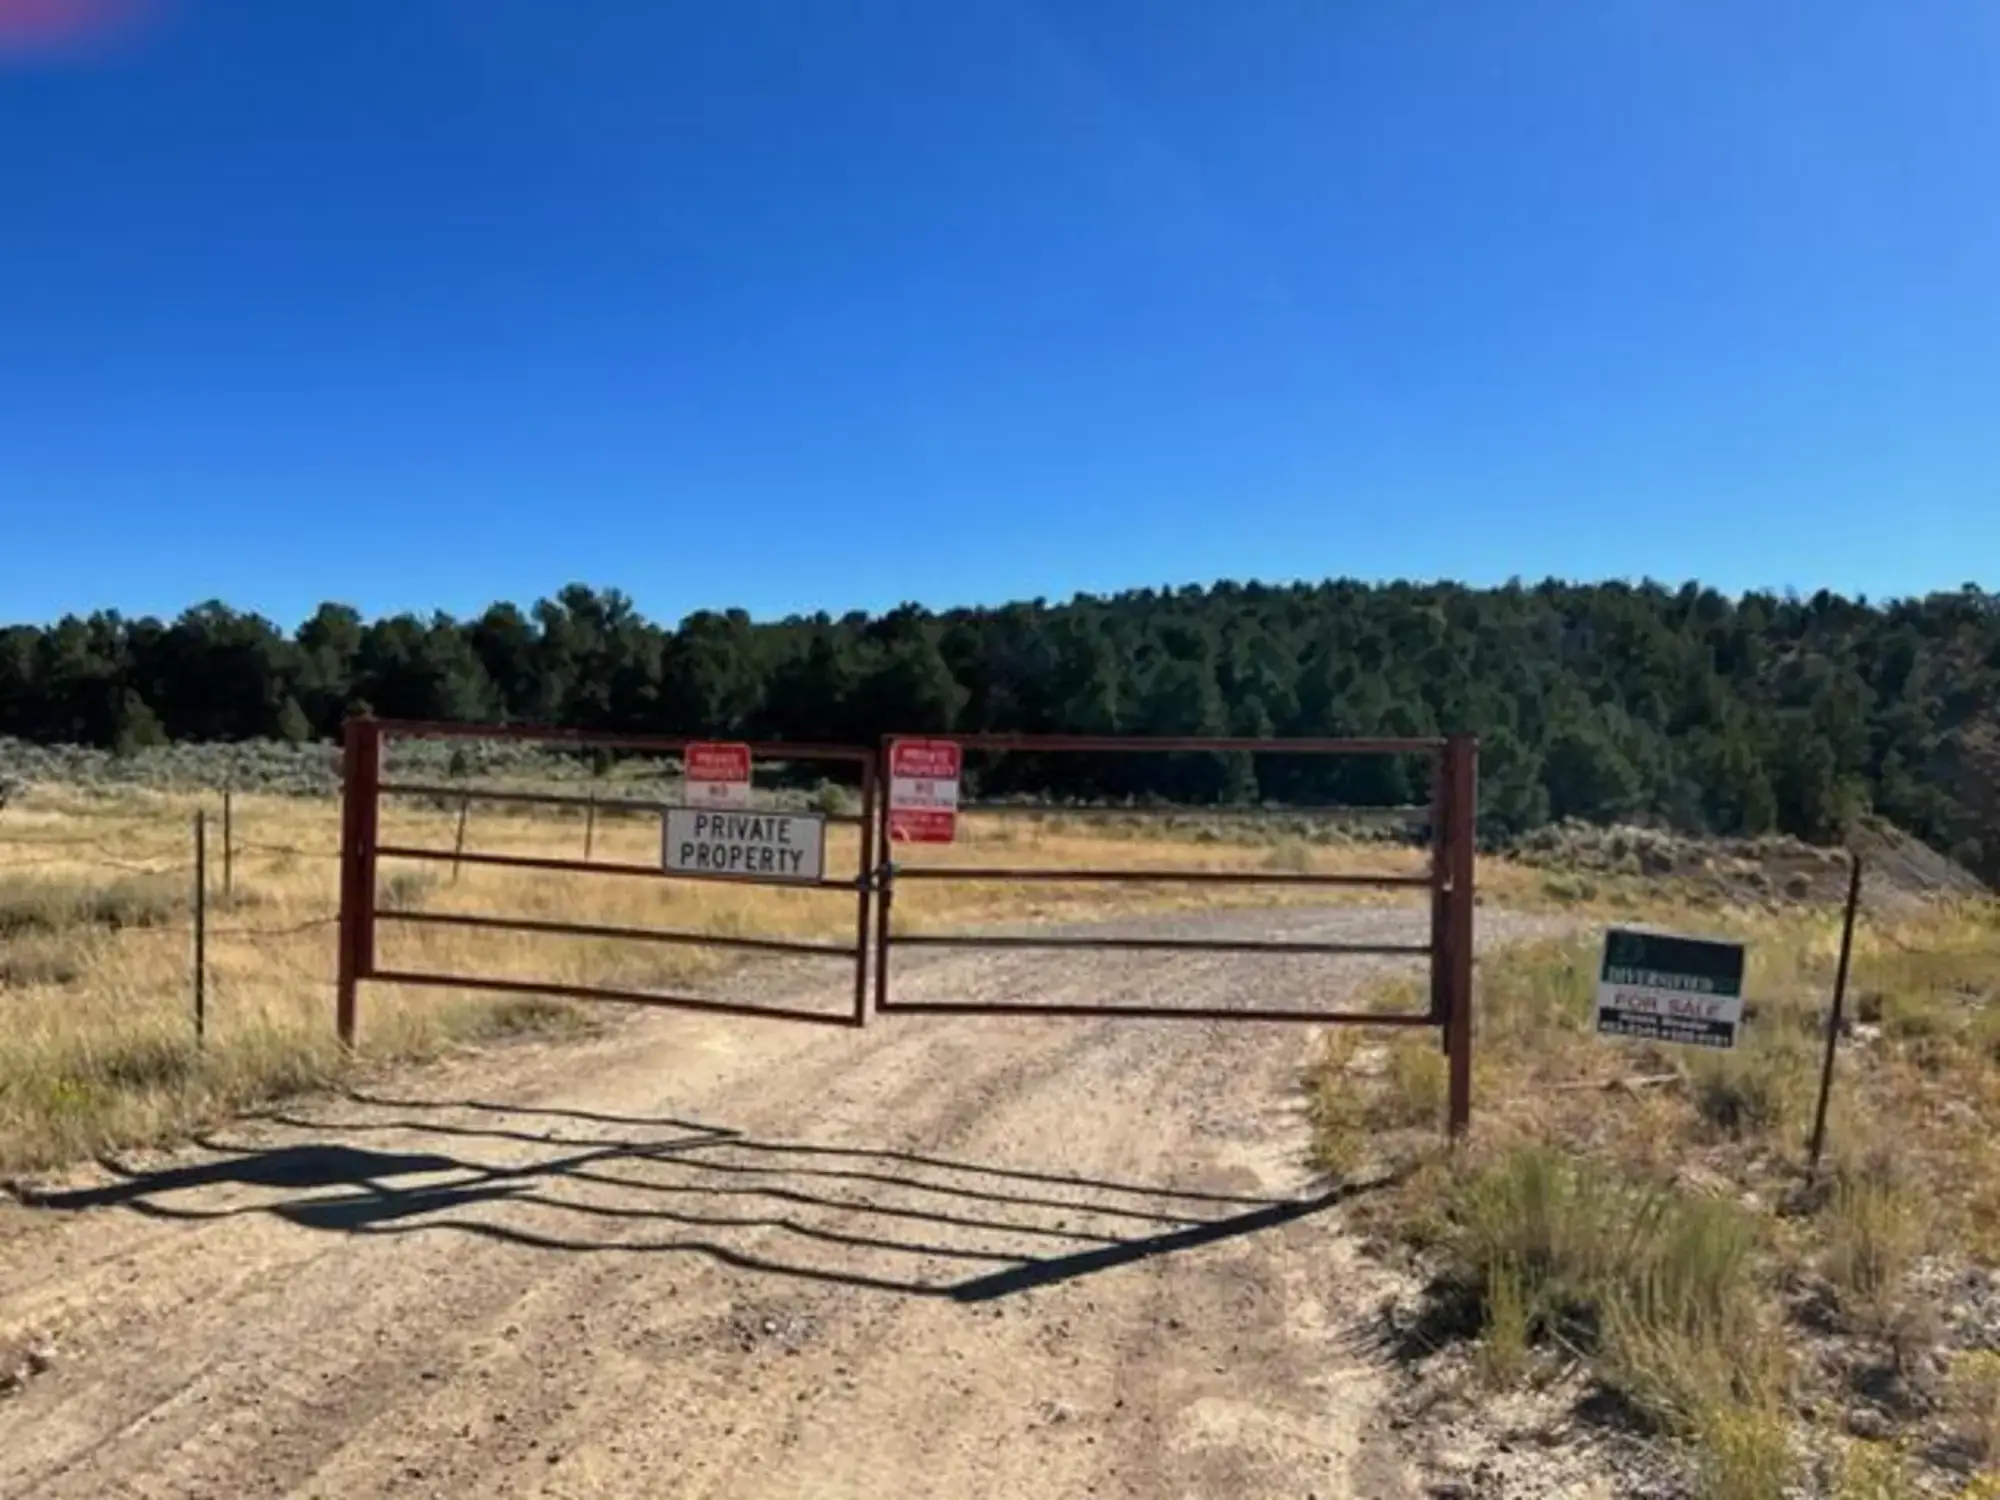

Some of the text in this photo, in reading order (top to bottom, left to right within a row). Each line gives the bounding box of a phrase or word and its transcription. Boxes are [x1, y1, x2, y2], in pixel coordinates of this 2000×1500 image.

[695, 814, 792, 843] PRIVATE
[680, 842, 805, 872] PROPERTY
[1614, 993, 1722, 1017] FOR SALE
